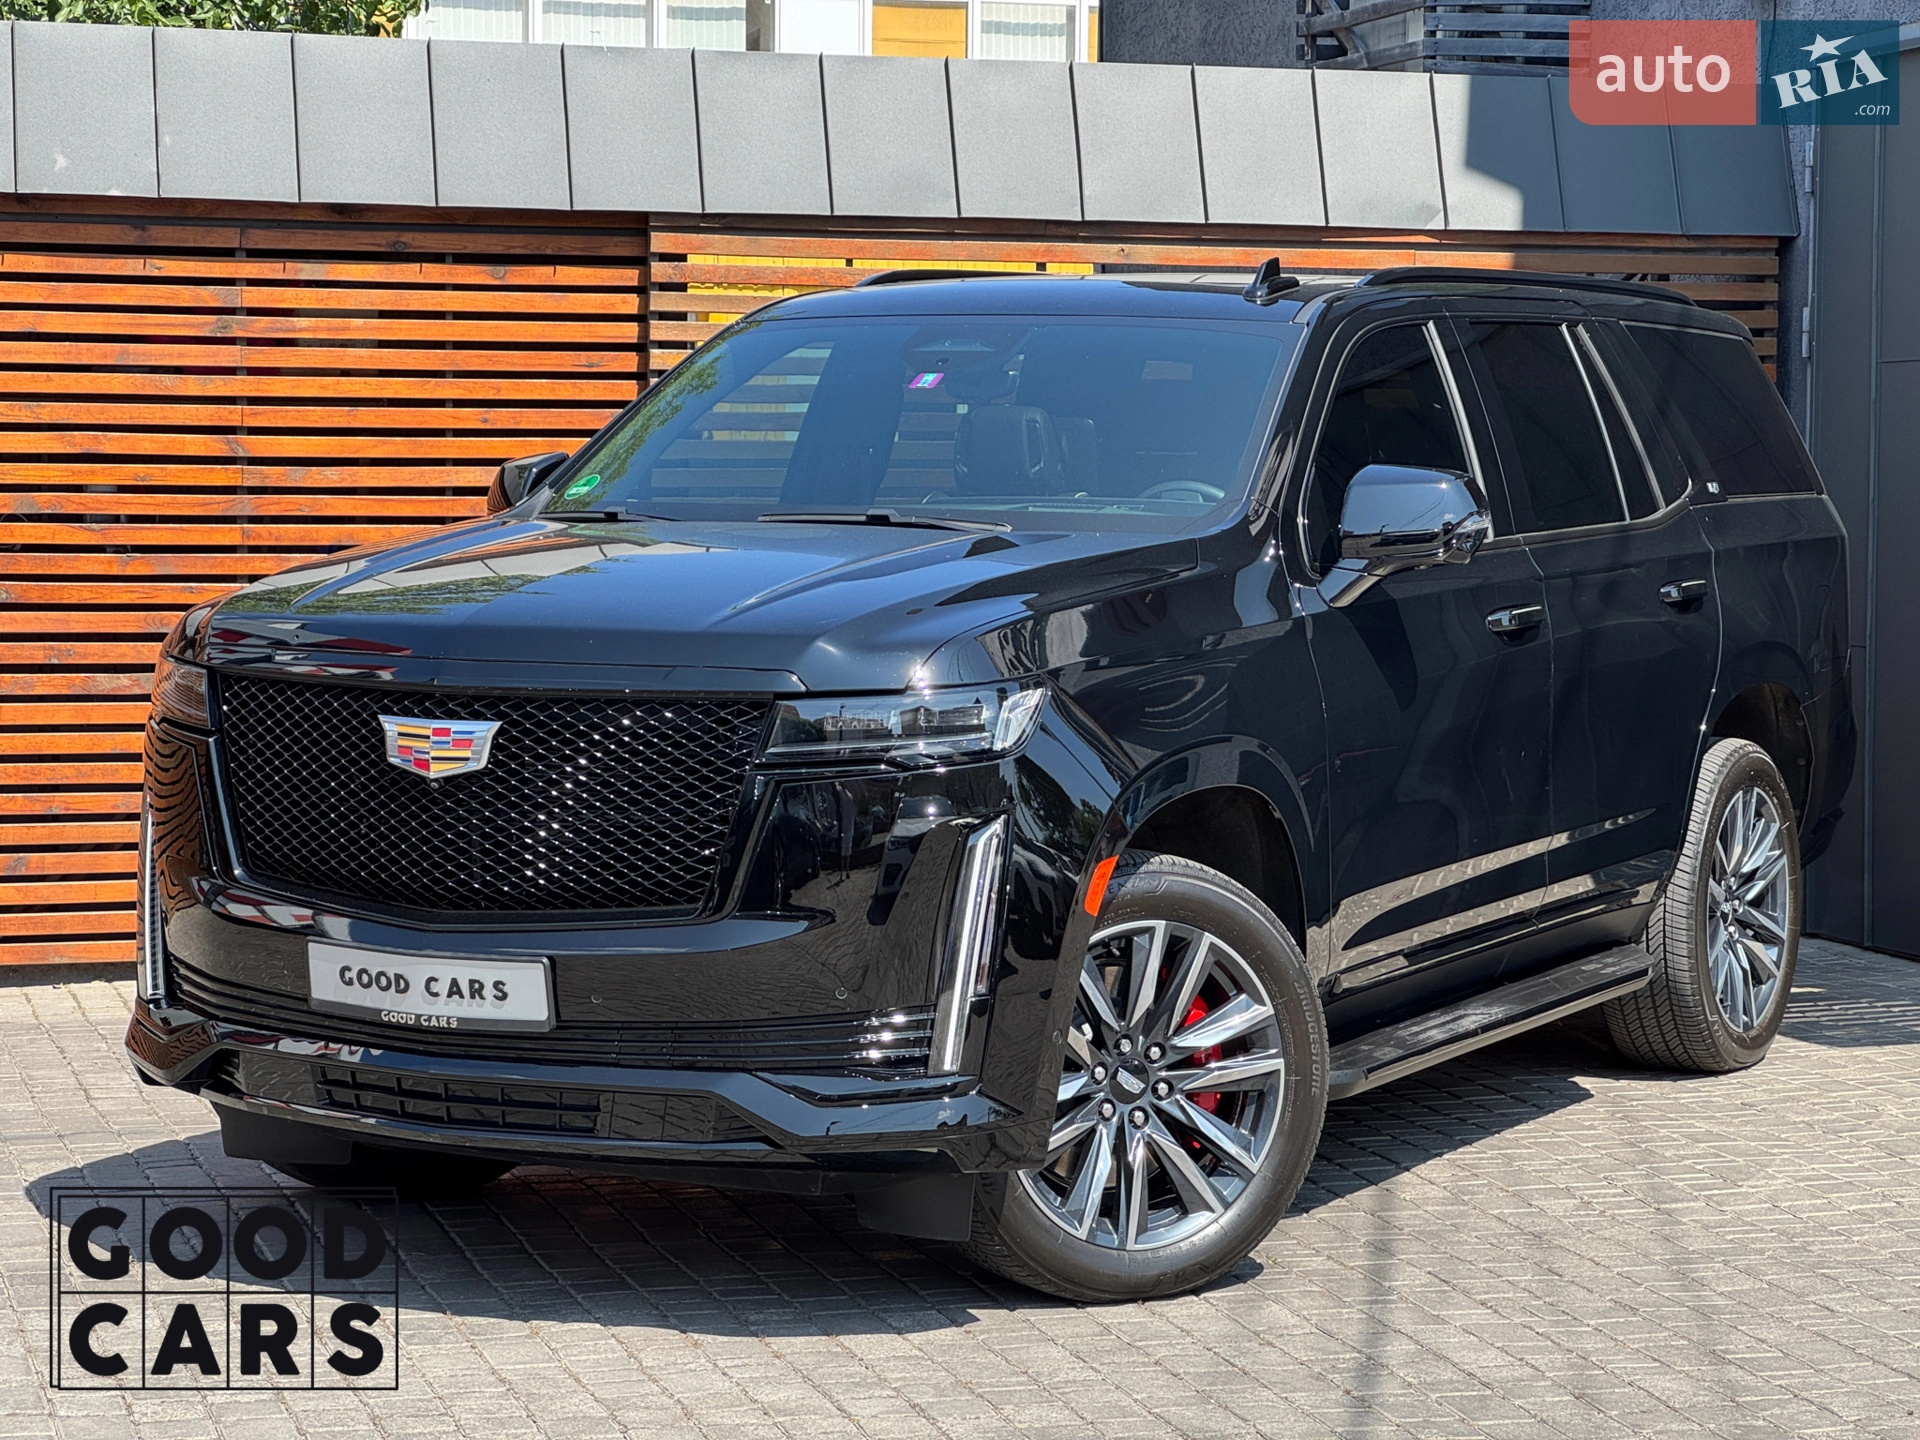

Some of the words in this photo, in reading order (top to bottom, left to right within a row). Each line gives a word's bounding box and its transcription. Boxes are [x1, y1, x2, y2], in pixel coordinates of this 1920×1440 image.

[338, 965, 410, 995] GOOD
[424, 976, 509, 1002] CARS
[380, 1010, 416, 1026] GOOD
[420, 1015, 458, 1029] CARS
[1293, 981, 1321, 1097] BRIDGESTONE
